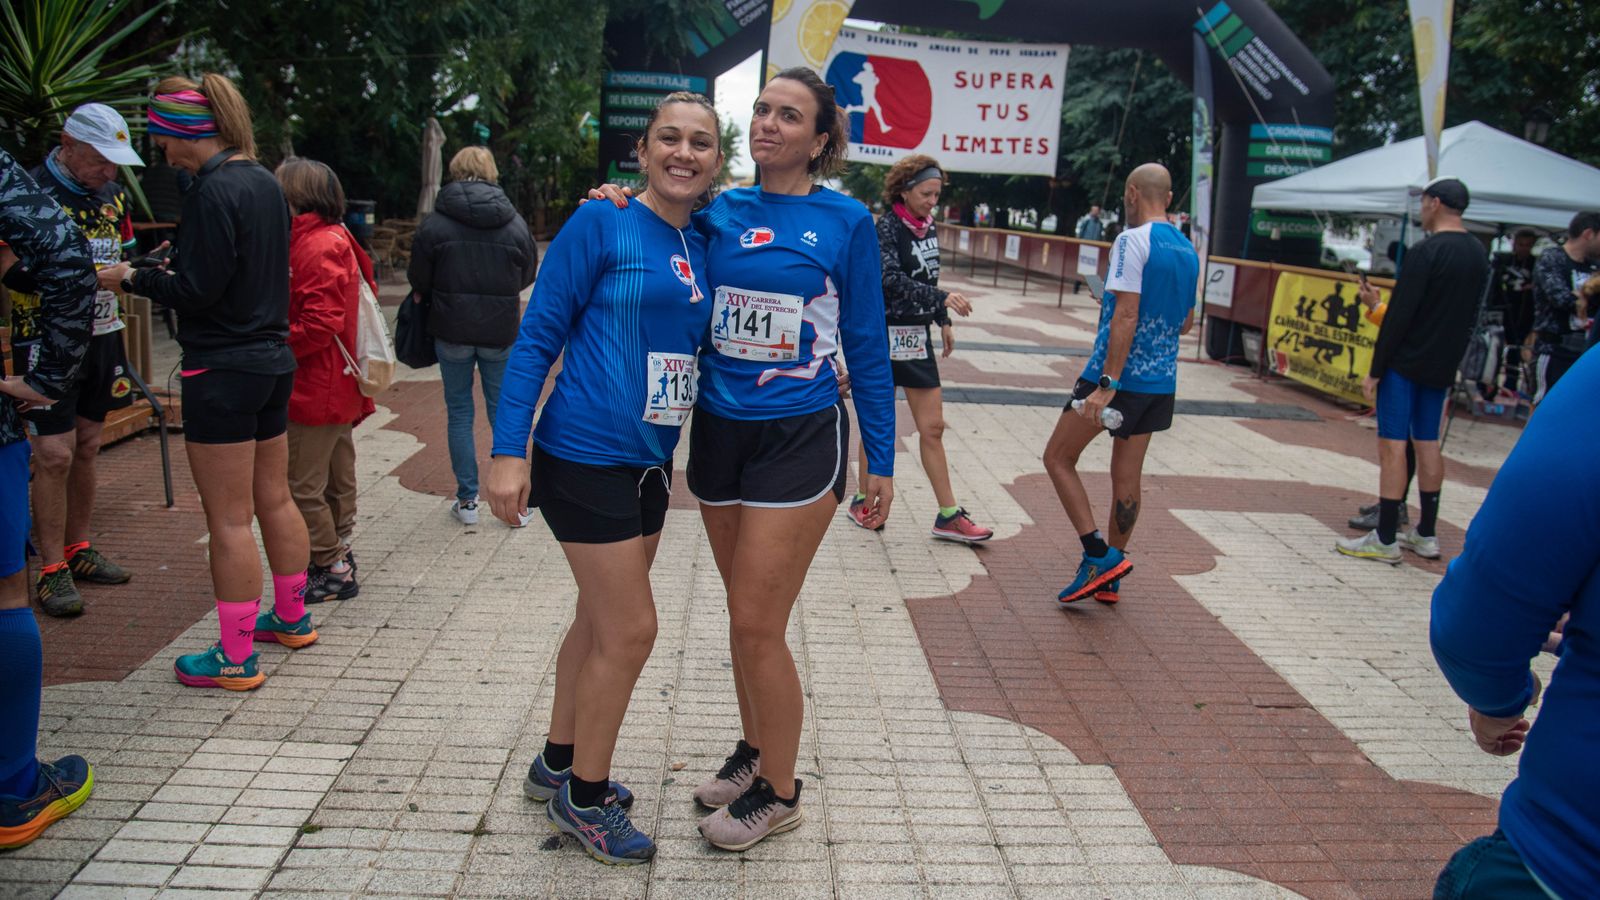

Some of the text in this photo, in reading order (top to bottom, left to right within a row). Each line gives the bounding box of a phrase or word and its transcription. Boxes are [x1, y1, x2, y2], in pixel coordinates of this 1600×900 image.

[954, 71, 1054, 90] SUPERA
[977, 103, 1029, 121] TUS
[941, 134, 1050, 155] LIMITES
[725, 292, 781, 308] XIV CARRERA
[750, 303, 798, 314] DEL ESTRECHO
[731, 307, 772, 339] 141
[900, 334, 919, 349] 462
[663, 358, 686, 373] XIV
[220, 666, 245, 676] HOKA
